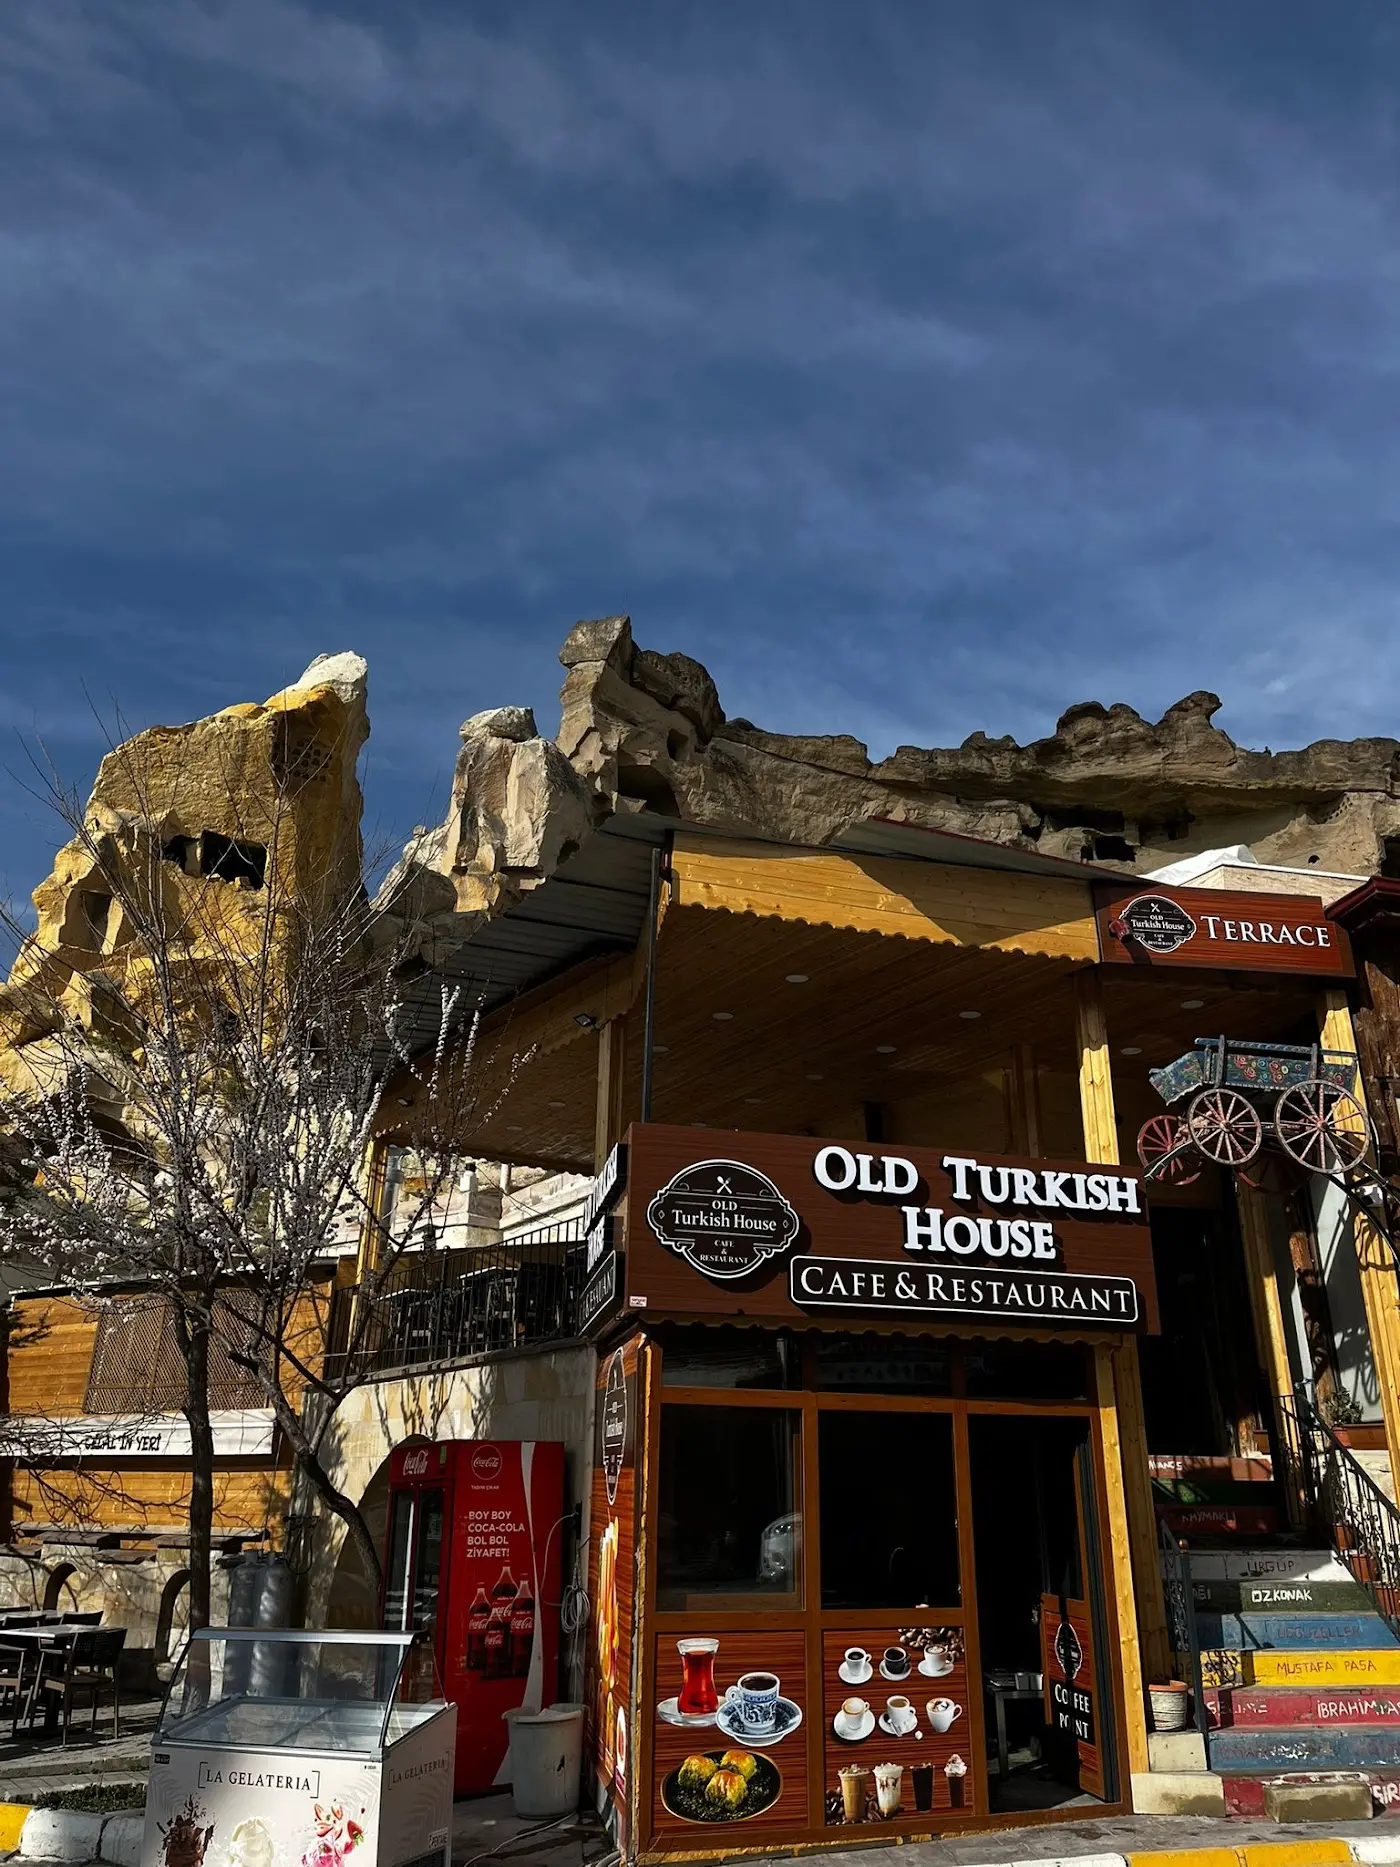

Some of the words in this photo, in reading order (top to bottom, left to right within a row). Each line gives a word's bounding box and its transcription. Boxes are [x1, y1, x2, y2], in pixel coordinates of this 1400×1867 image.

[1130, 919, 1162, 929] Turkish
[1162, 921, 1185, 930] House
[1200, 915, 1331, 948] TERRACE
[814, 1145, 919, 1195] OLD
[942, 1155, 1142, 1213] TURKISH
[711, 1200, 738, 1211] OLD
[671, 1209, 730, 1228] Turkish
[733, 1213, 777, 1231] House
[901, 1206, 1056, 1259] HOUSE
[714, 1239, 735, 1248] CAFE
[700, 1254, 749, 1264] RESTAURANT
[800, 1266, 887, 1299] CAFE
[894, 1270, 921, 1301] &
[926, 1272, 1131, 1313] RESTAURANT
[403, 1448, 429, 1476] Coca-Cola
[473, 1456, 500, 1468] Coca-Cola
[468, 1511, 490, 1520] BOY
[491, 1511, 512, 1520] BOY
[467, 1523, 525, 1532] COCA-COLA
[467, 1536, 487, 1545] BOL
[489, 1535, 509, 1545] BOL
[466, 1547, 510, 1558] ZİYAFET!
[1276, 1661, 1334, 1676] MUSTAFA
[392, 1773, 402, 1784] LA
[404, 1758, 446, 1780] GELATERIA
[206, 1769, 223, 1783] LA
[229, 1771, 312, 1791] GELATERIA
